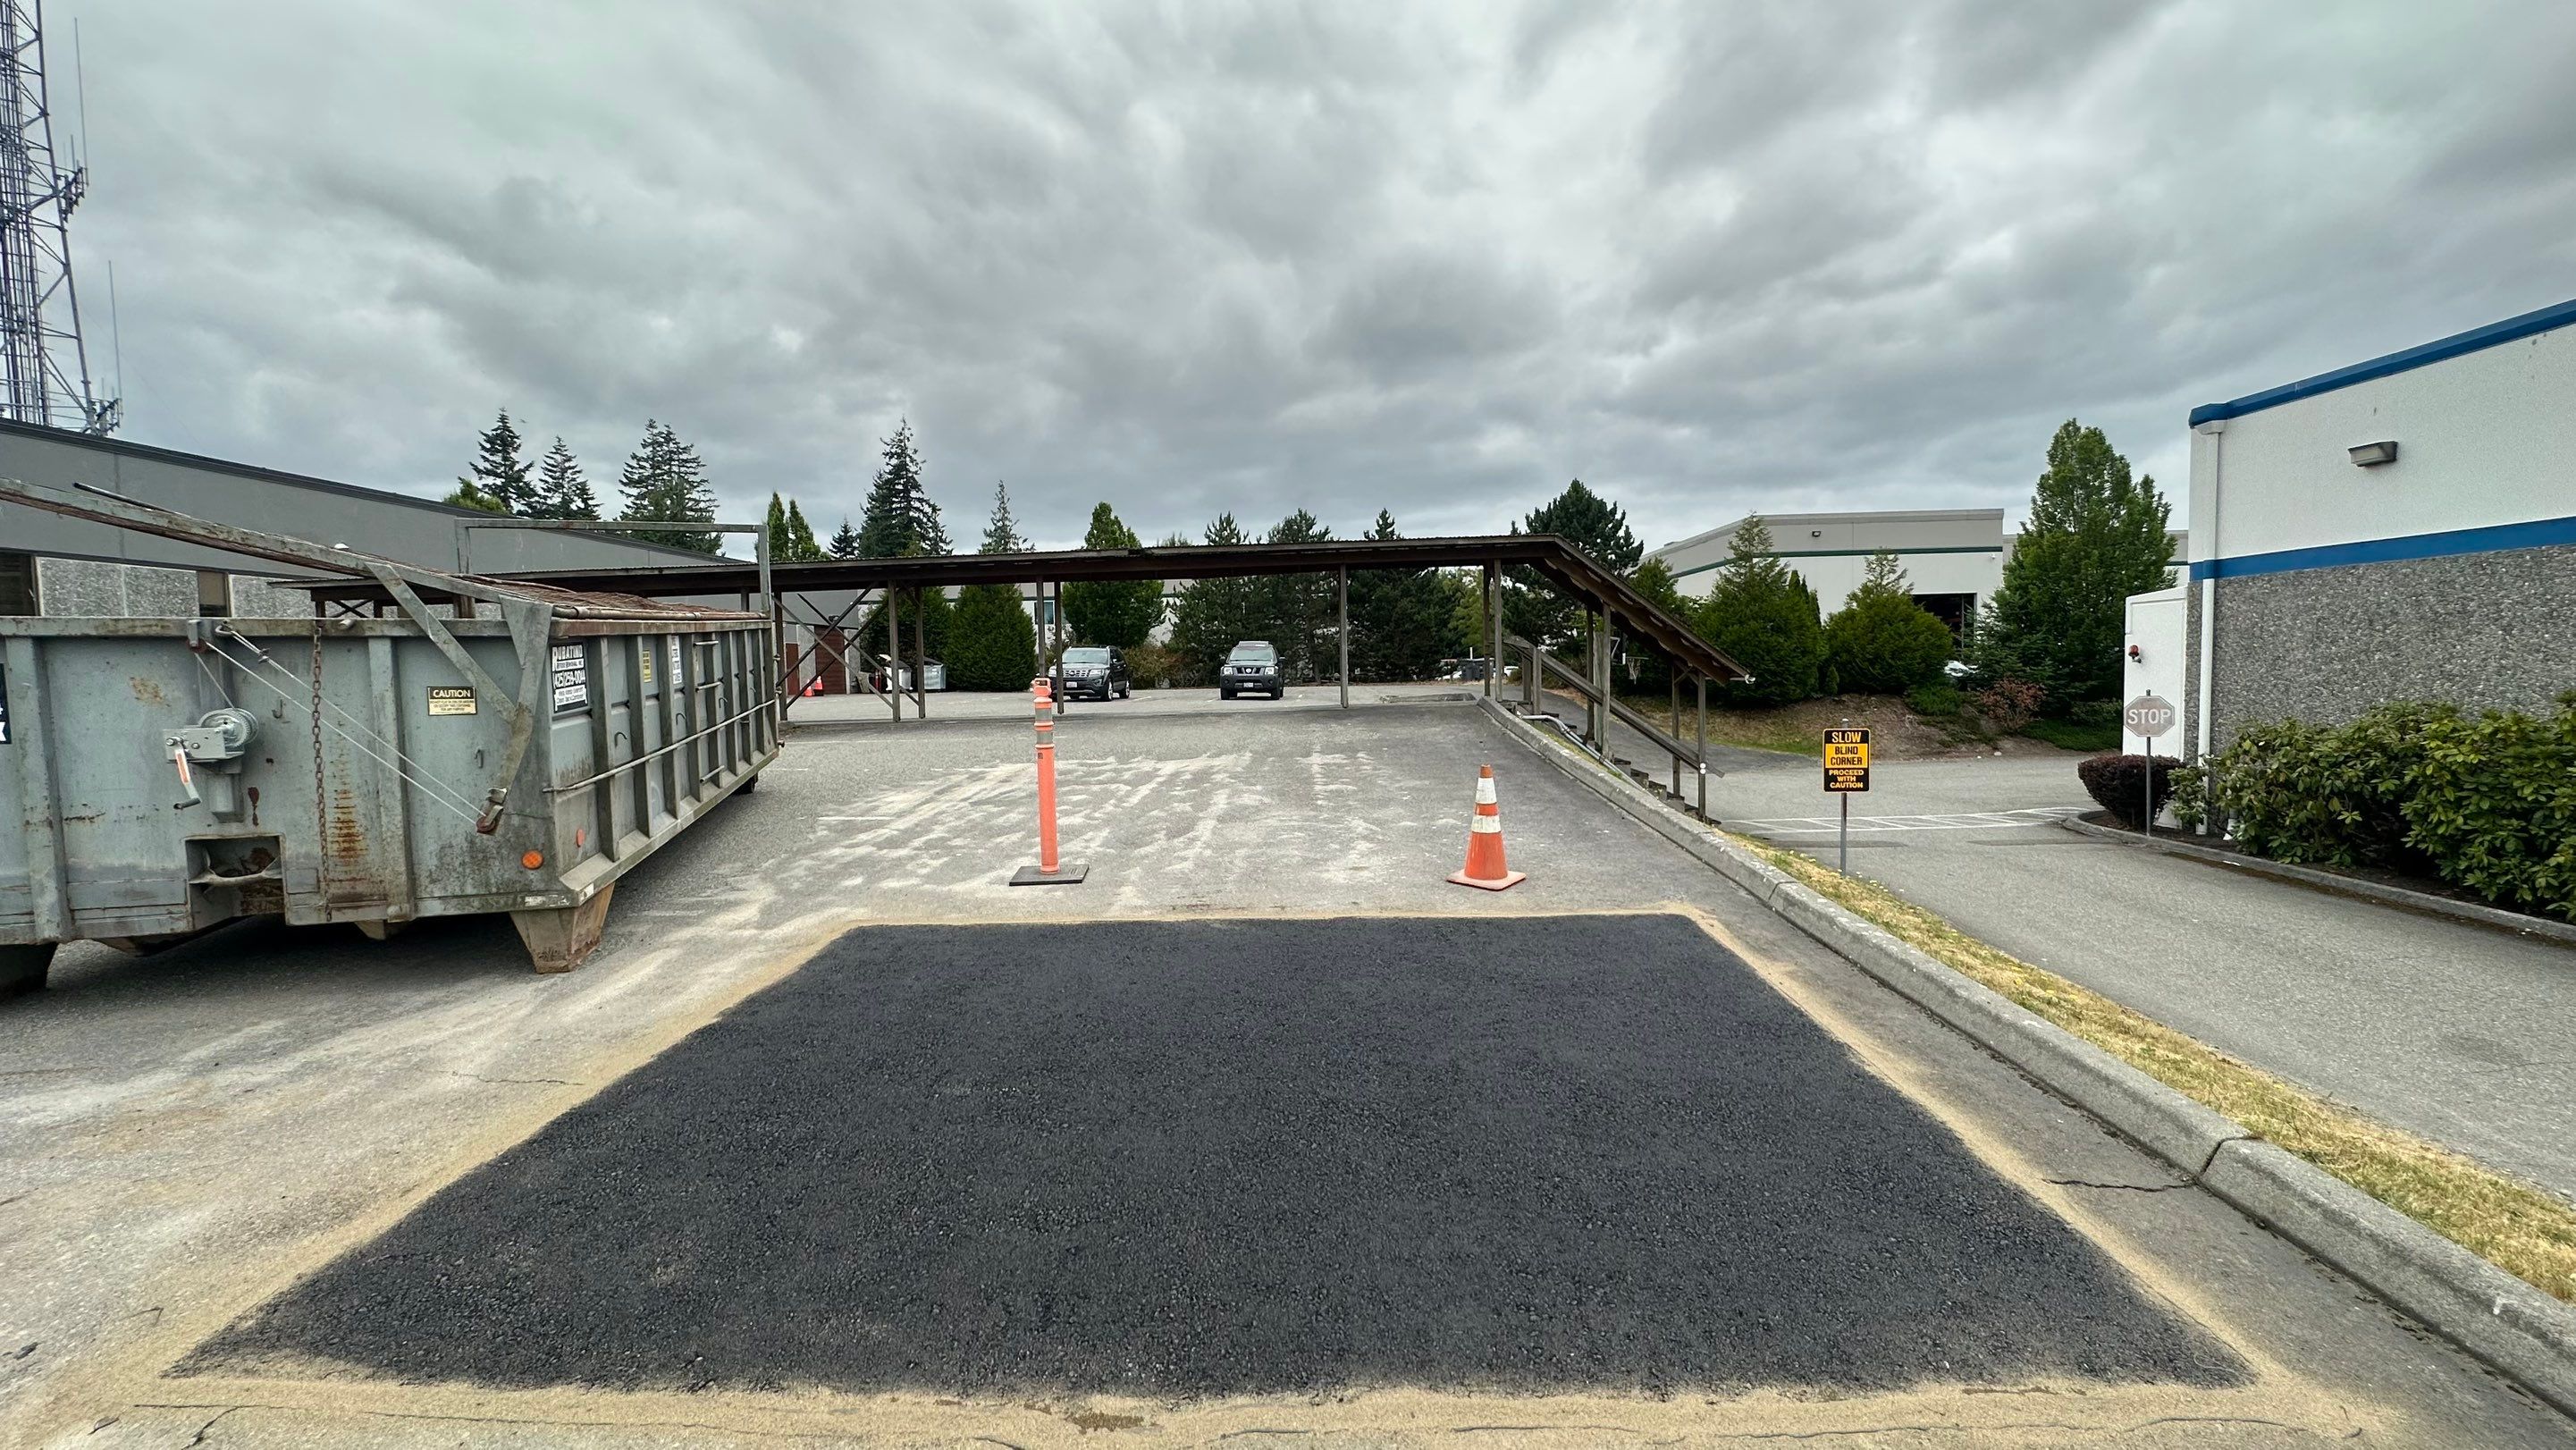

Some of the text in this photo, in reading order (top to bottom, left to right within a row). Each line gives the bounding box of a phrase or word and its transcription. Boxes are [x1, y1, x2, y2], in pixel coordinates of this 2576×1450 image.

[434, 689, 470, 697] CAUTION
[2127, 709, 2171, 724] STOP
[1831, 731, 1861, 742] SLOW
[1835, 746, 1858, 755] BLIND
[1831, 757, 1862, 765] CORNER
